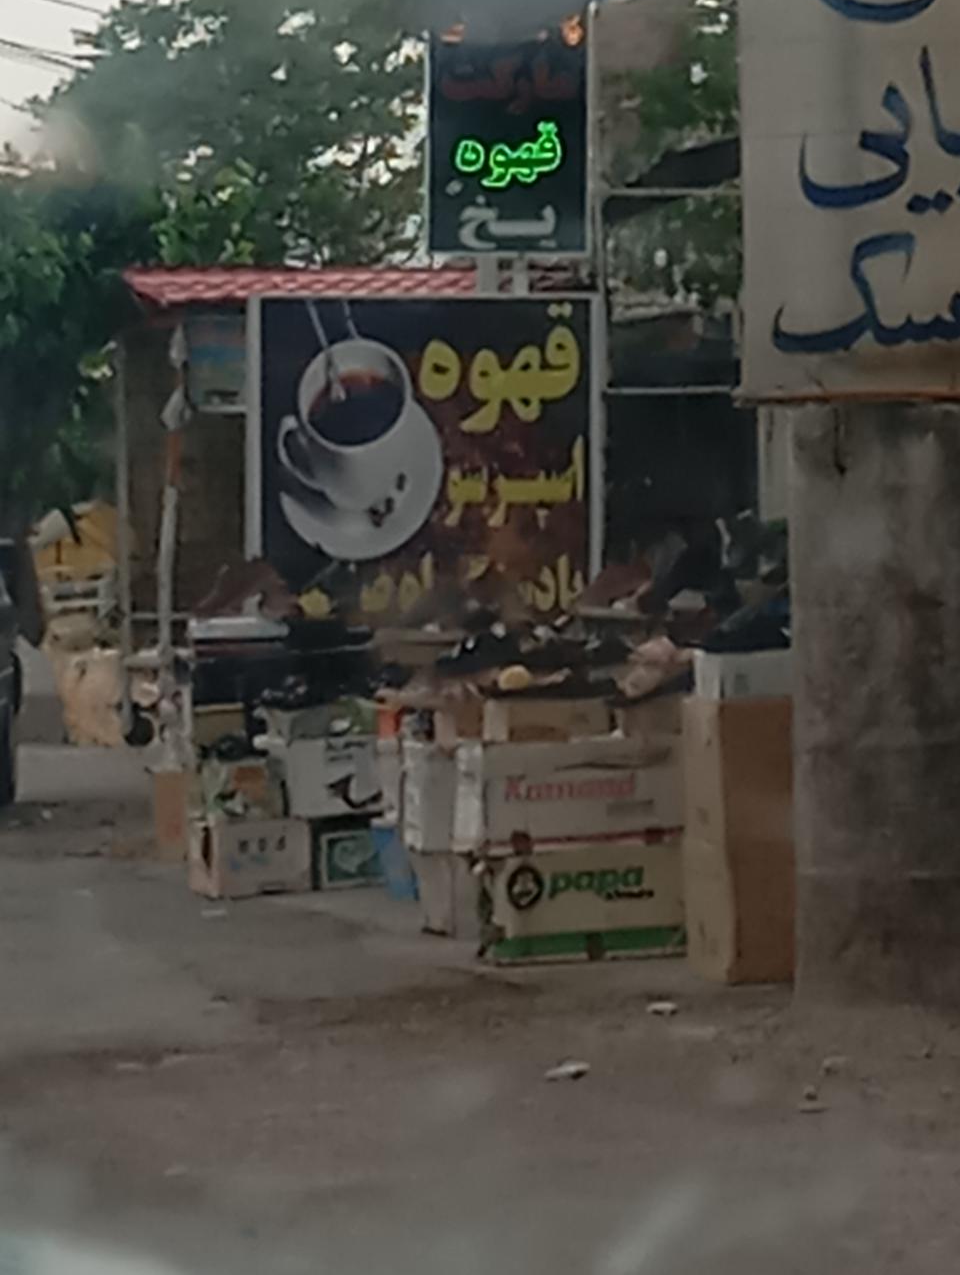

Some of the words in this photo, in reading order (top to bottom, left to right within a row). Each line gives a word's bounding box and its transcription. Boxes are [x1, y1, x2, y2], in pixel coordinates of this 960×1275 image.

[455, 121, 561, 188] قهوه
[420, 302, 581, 432] قهوه
[548, 866, 645, 901] papa
